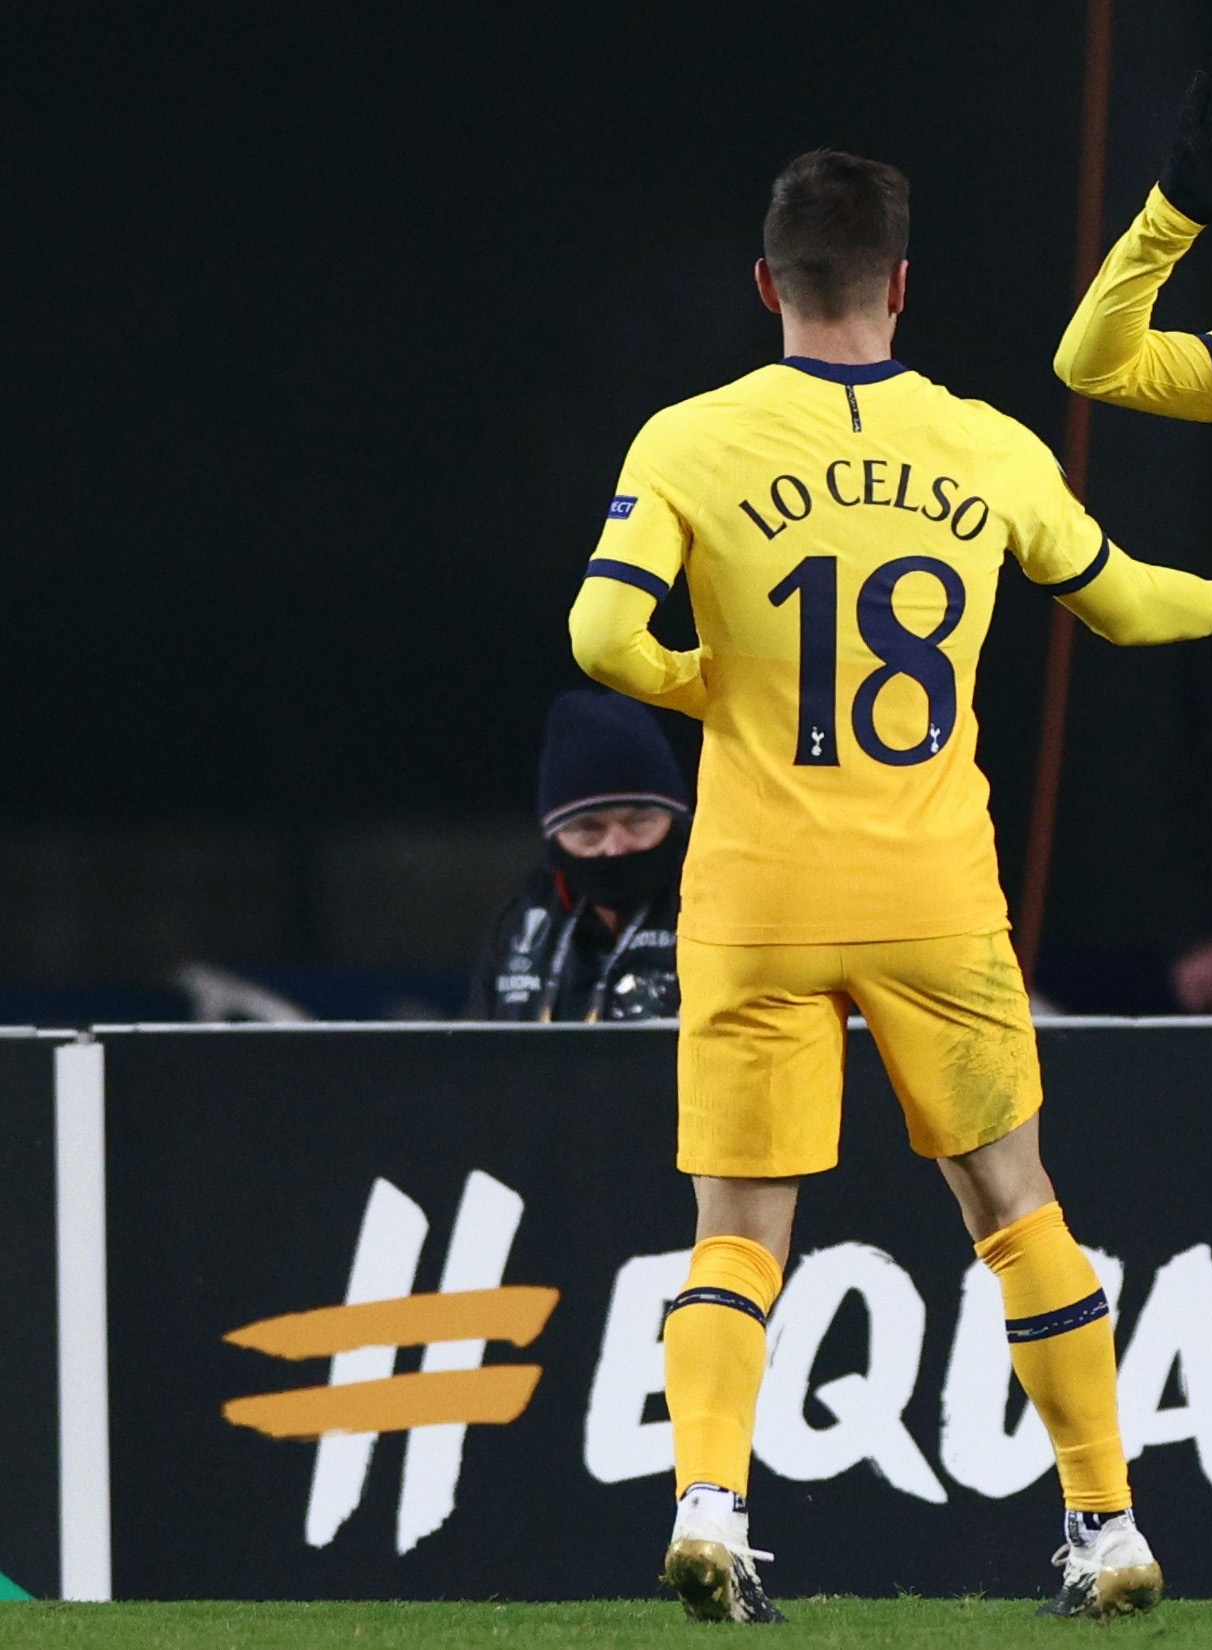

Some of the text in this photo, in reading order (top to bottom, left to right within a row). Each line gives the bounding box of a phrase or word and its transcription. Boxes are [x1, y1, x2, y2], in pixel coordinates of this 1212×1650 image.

[738, 459, 990, 541] LO CELSO
[767, 555, 966, 767] 18
